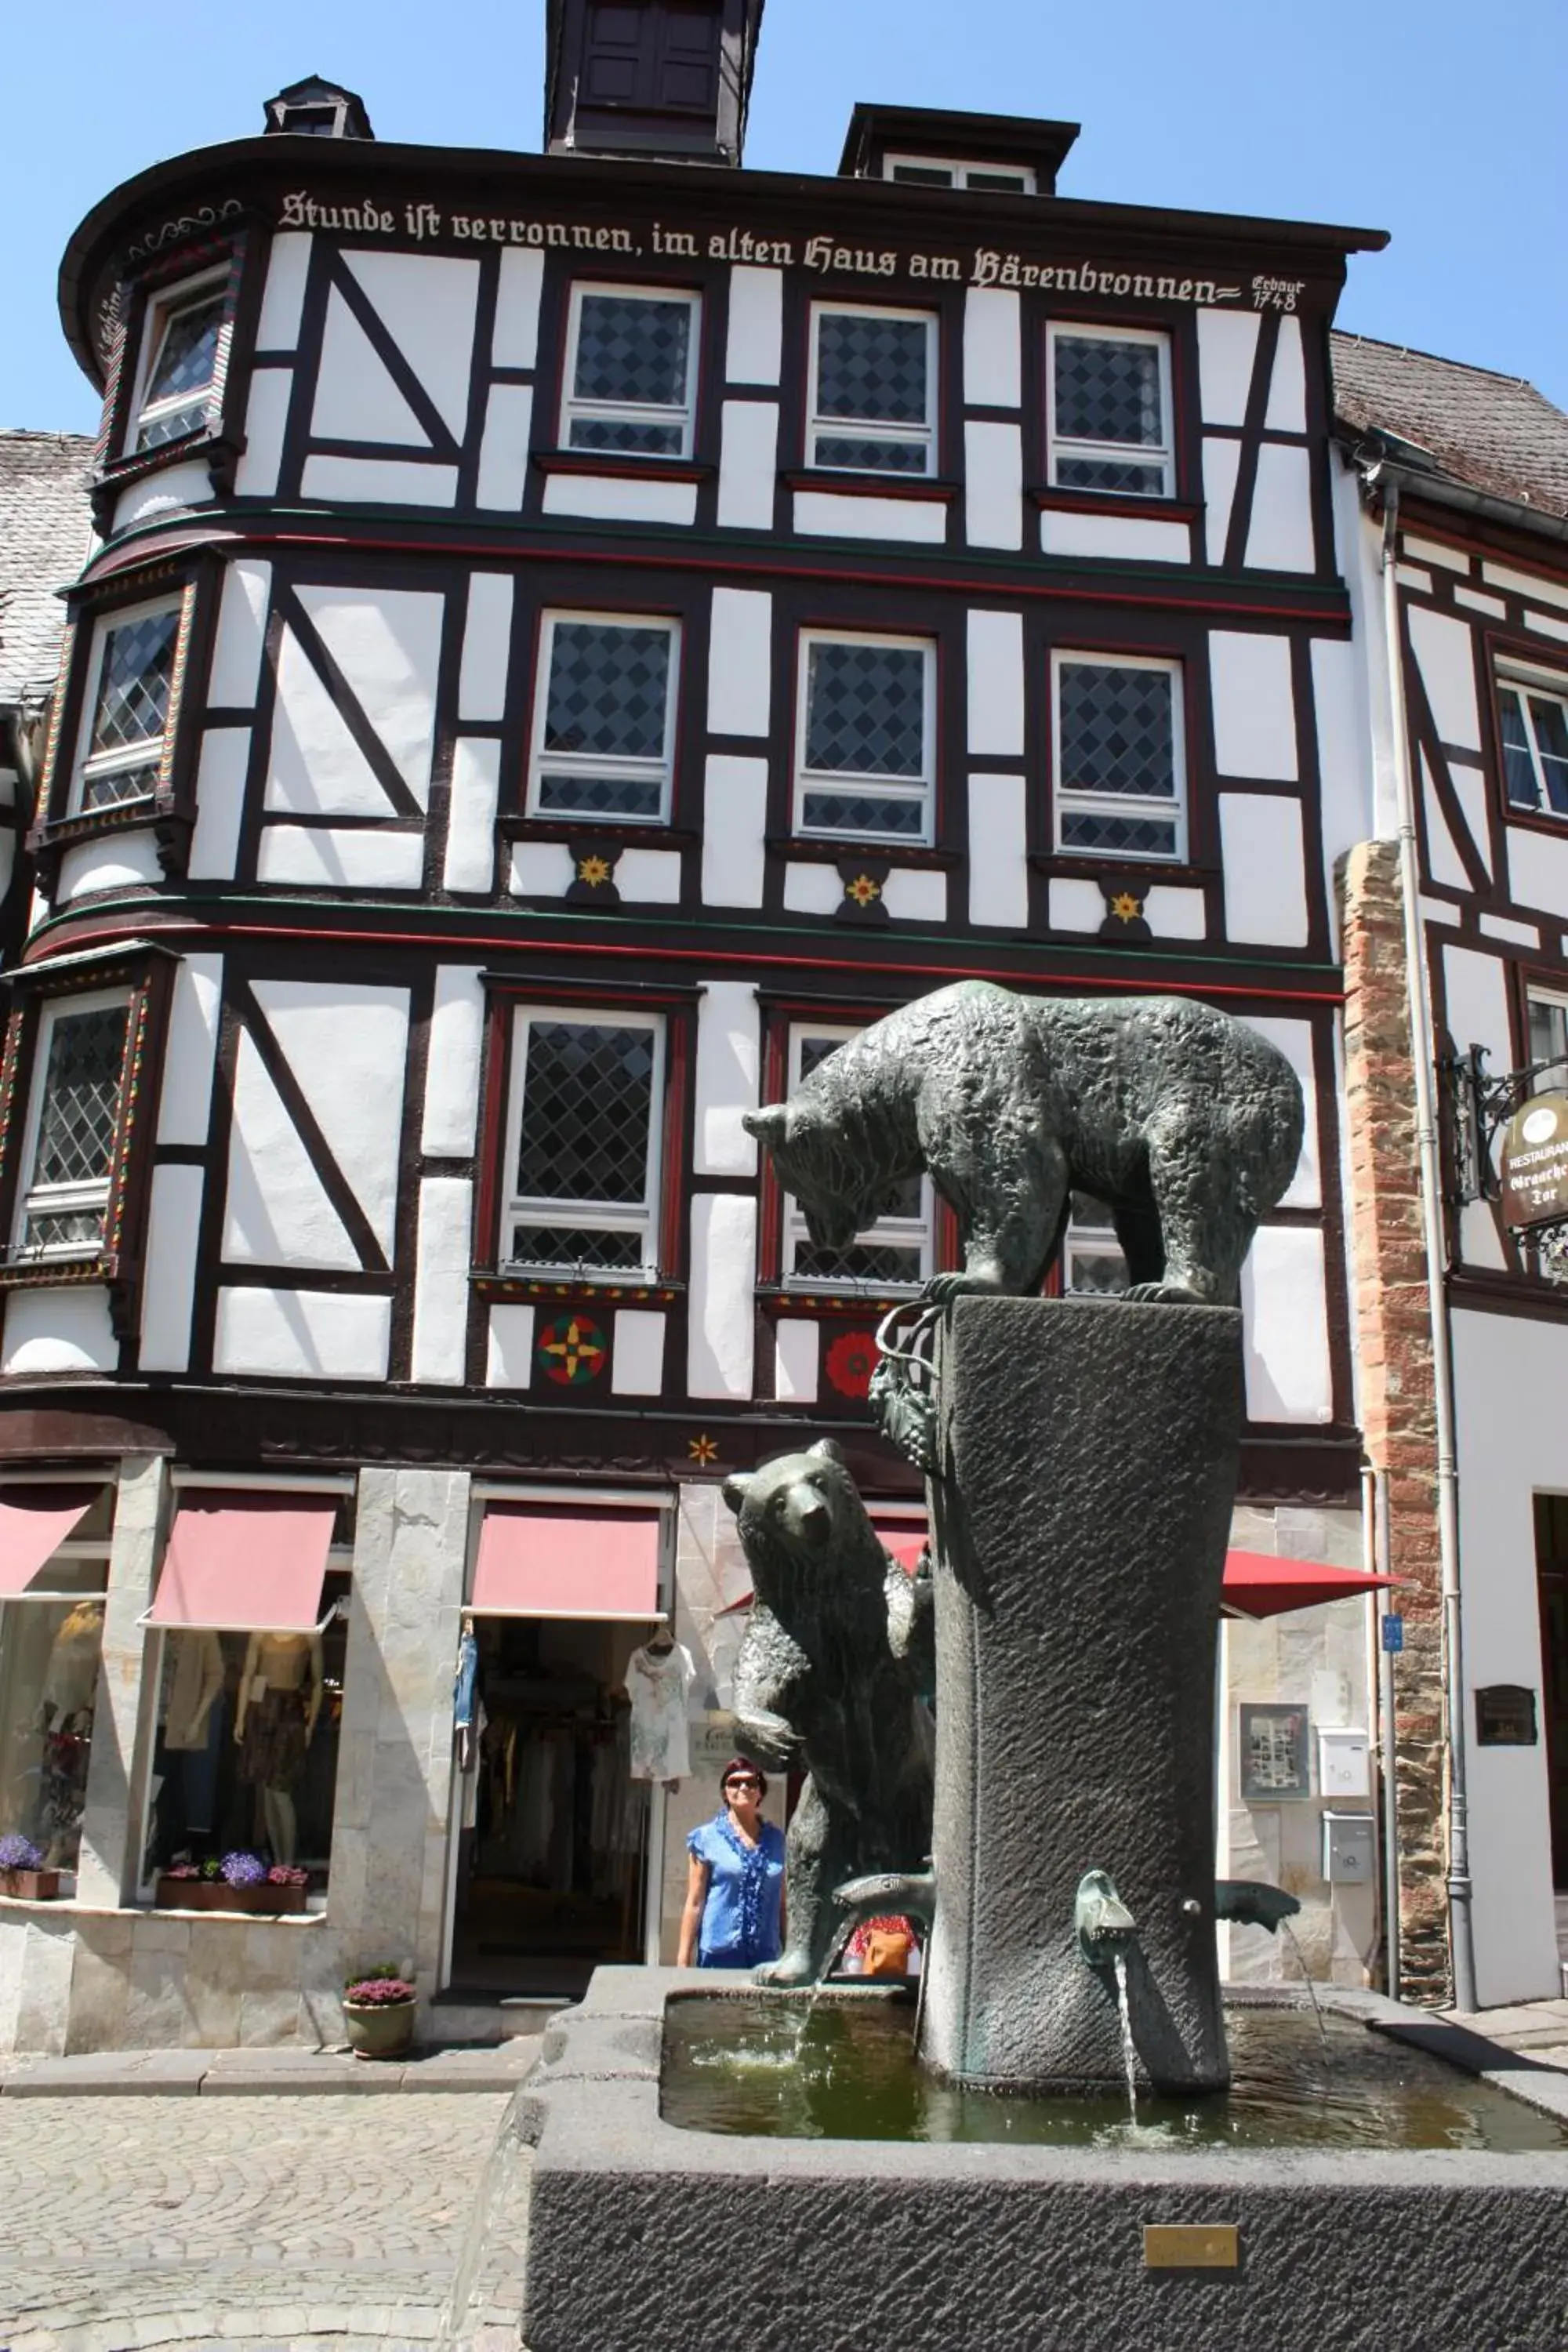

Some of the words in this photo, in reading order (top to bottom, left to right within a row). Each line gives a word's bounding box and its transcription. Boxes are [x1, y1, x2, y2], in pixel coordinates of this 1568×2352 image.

[278, 191, 395, 233] Stunde
[452, 216, 643, 256] verronnen,
[652, 223, 699, 256] im
[709, 227, 795, 265] alten
[803, 236, 897, 275] Haus
[909, 254, 961, 280] am
[1251, 275, 1306, 295] Erbaut
[1253, 291, 1297, 311] 1748
[1509, 1141, 1568, 1170] RESTAURAN
